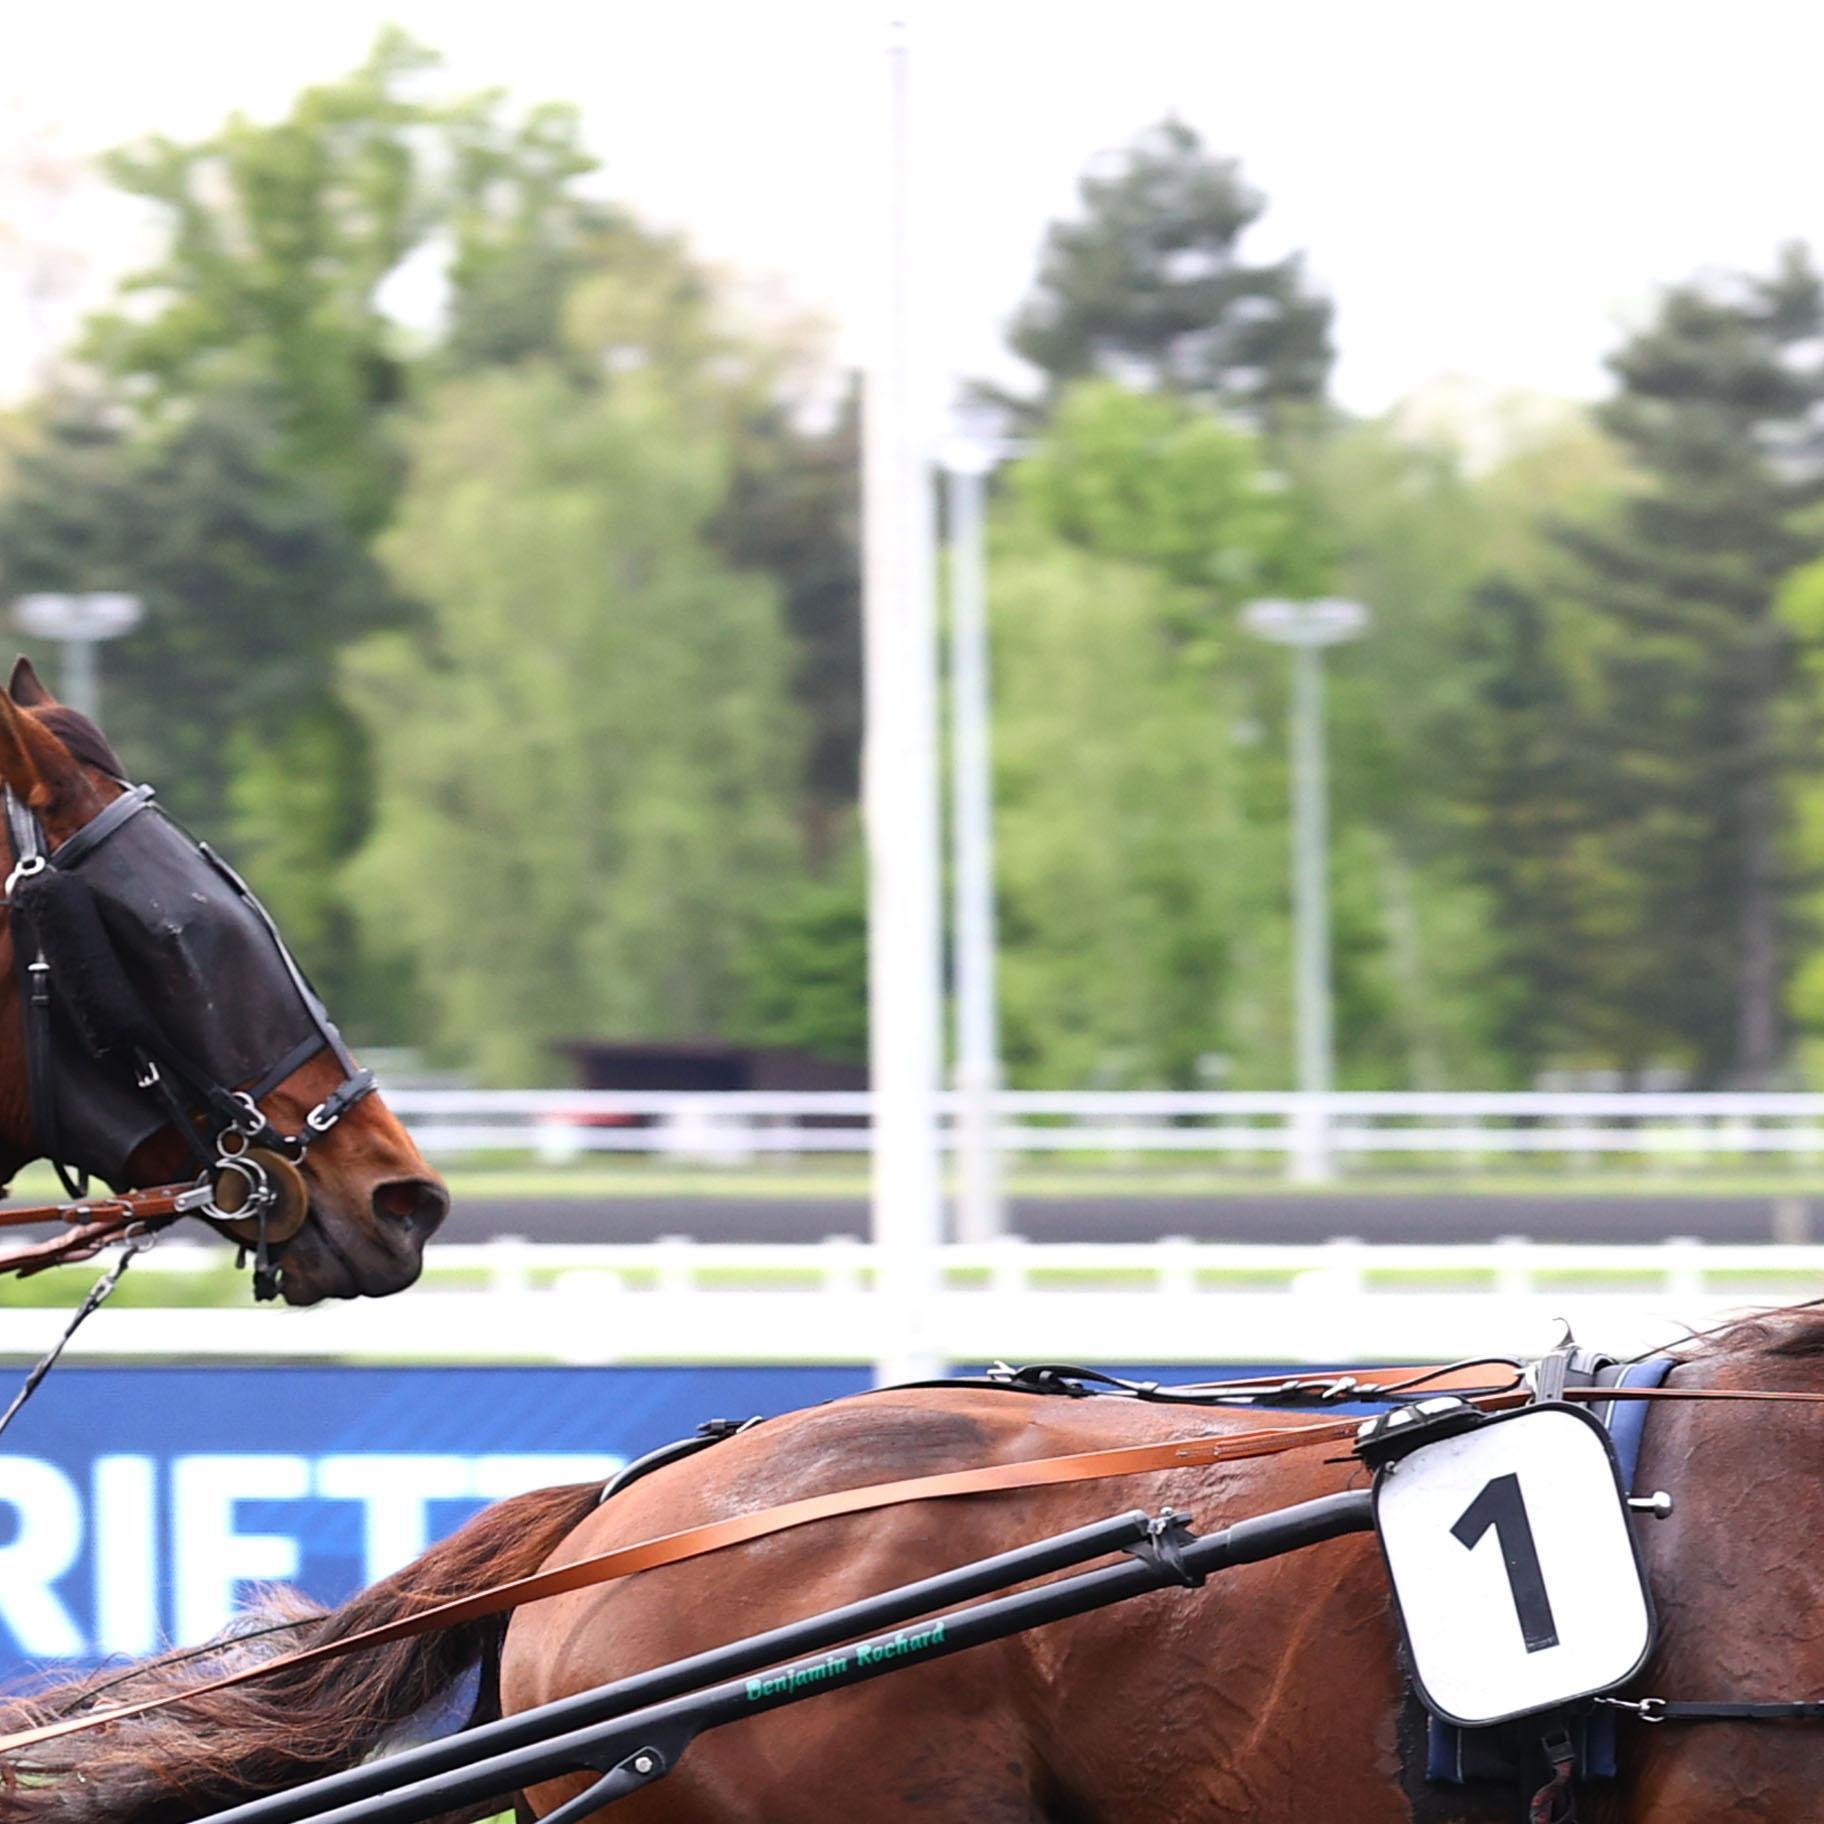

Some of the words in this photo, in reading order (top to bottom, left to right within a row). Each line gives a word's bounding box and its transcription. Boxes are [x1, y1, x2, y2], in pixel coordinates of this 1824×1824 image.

[1449, 1472, 1560, 1654] 1
[745, 1656, 849, 1700] Benjamin
[855, 1621, 946, 1667] Rochard
